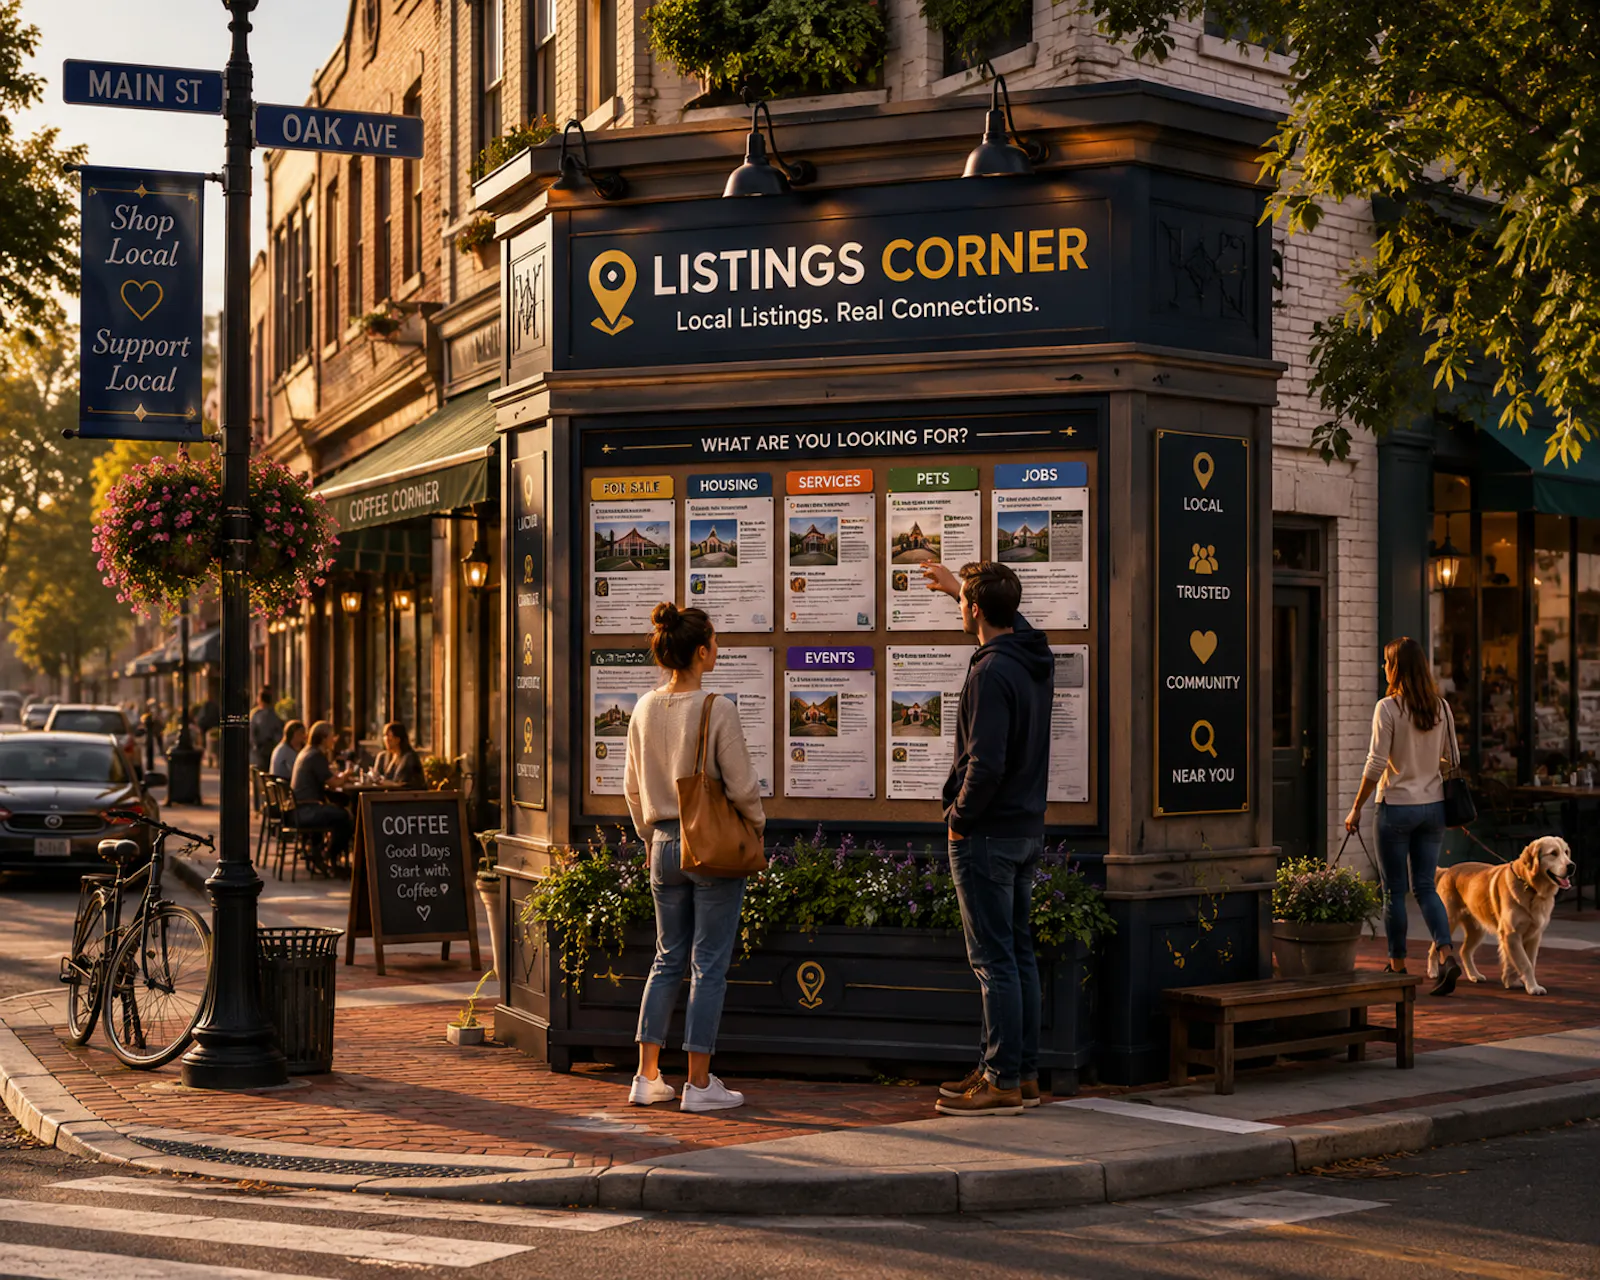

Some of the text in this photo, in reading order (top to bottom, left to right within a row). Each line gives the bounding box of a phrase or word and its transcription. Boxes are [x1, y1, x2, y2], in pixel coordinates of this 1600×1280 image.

[88, 69, 202, 104] MAIN ST
[282, 113, 397, 149] OAK AVE
[111, 205, 174, 240] Shop
[105, 240, 178, 267] Local
[655, 228, 1088, 295] LISTINGS CORNER
[678, 293, 1039, 330] Local Listings. Real Connections.
[93, 329, 191, 363] Support
[106, 365, 177, 392] Local
[700, 427, 969, 453] WHAT ARE YOU LOOKING FOR?
[700, 478, 759, 492] HOUSING
[799, 475, 861, 488] SERVICES
[916, 471, 950, 486] PETS
[1021, 468, 1058, 482] JOBS
[349, 493, 389, 522] COFFEE
[1183, 496, 1224, 513] LOCAL
[1176, 584, 1231, 600] TRUSTED
[805, 651, 856, 664] EVENTS
[1166, 675, 1241, 690] COMMUNITY
[1172, 767, 1235, 784] NEAR YOU
[382, 814, 450, 836] COFFEE
[384, 842, 451, 861] Good Days
[389, 863, 421, 879] Start
[396, 881, 438, 902] Coffee
